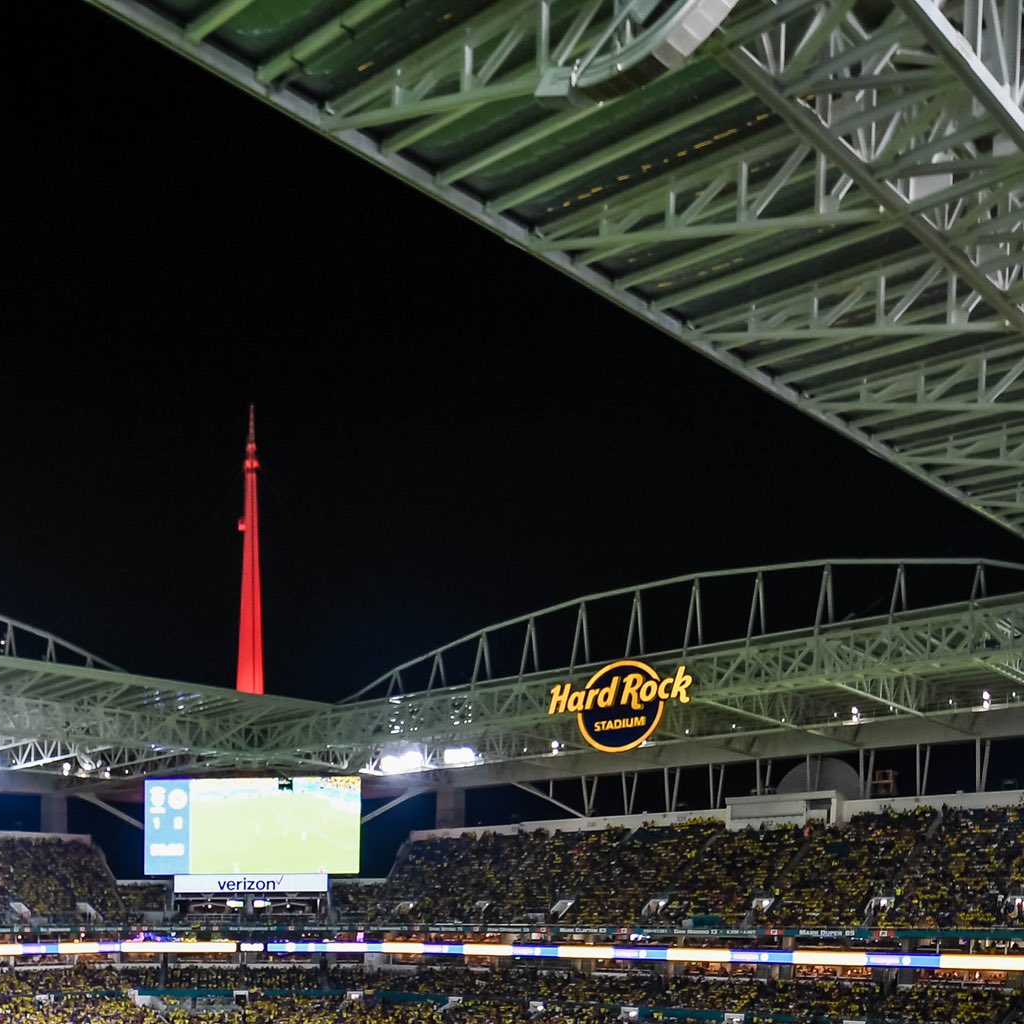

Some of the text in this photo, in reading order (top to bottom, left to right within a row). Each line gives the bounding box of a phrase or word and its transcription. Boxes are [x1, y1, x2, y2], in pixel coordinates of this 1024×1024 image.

[548, 665, 693, 715] Hard Rock
[594, 715, 647, 732] STADIUM
[217, 878, 276, 892] verizon
